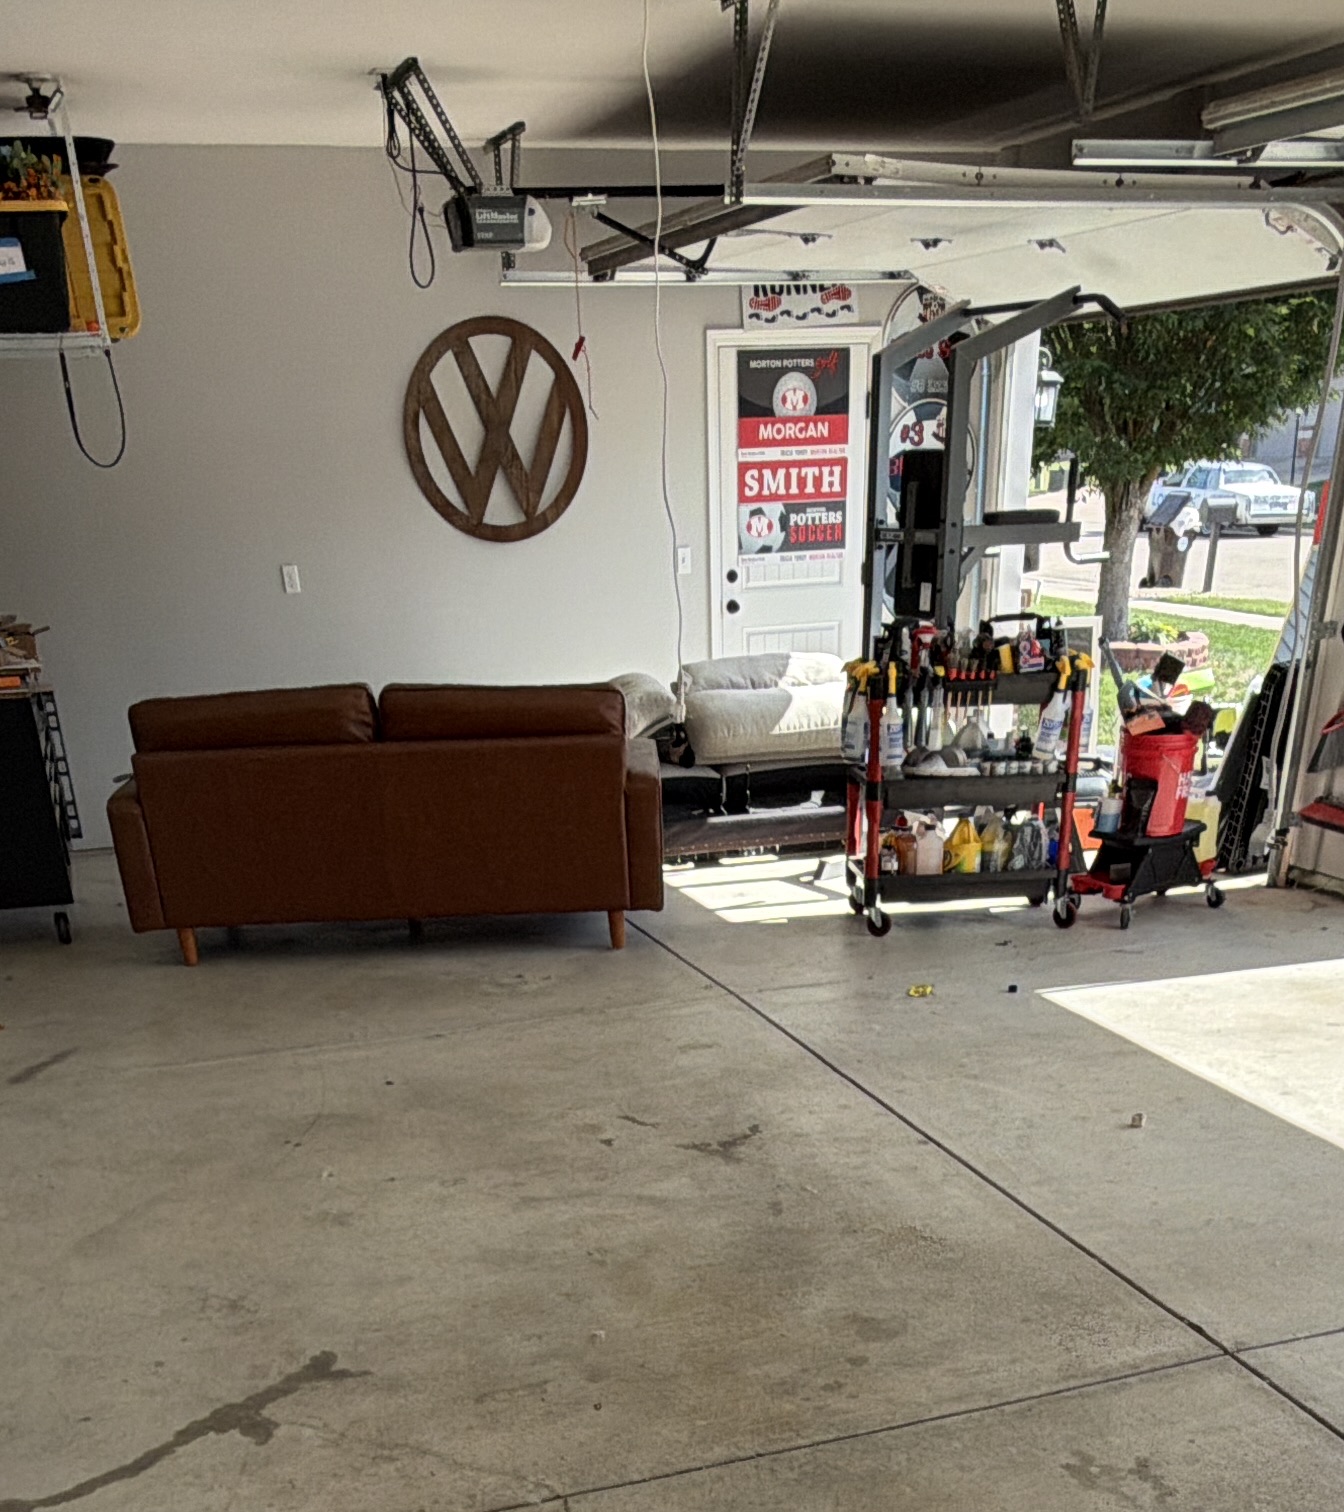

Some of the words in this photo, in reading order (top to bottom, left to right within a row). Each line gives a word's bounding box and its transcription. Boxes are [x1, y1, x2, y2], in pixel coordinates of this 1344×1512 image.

[476, 210, 518, 220] LiftMaster
[749, 359, 782, 369] MORTON
[783, 357, 814, 368] POTTERS
[759, 421, 829, 440] MORGAN
[744, 465, 842, 497] SMITH
[789, 511, 843, 526] POTTERS
[789, 525, 843, 544] SOCCER
